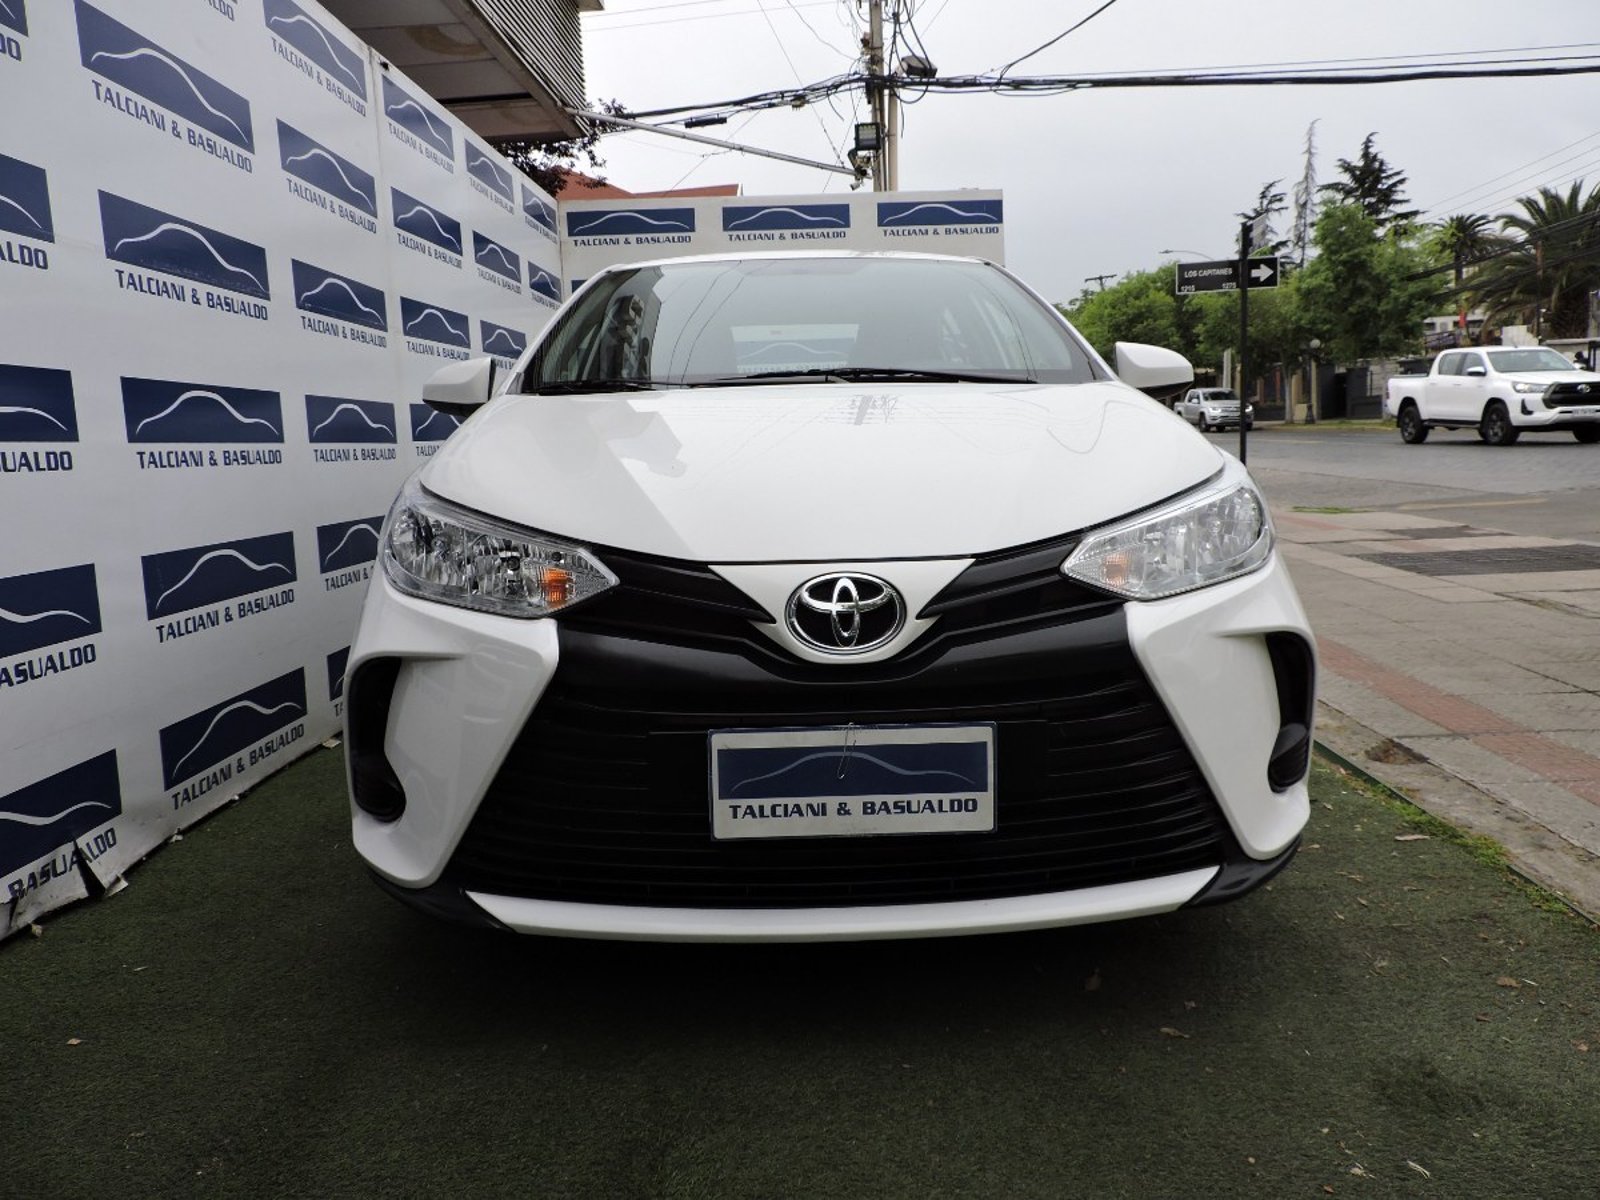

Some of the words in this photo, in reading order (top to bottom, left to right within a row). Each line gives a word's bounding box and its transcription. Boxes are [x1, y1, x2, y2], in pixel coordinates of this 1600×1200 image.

[272, 37, 314, 79] TALCIANI
[325, 77, 366, 117] BASUALDO
[92, 79, 166, 131] TALCIANI
[172, 120, 182, 139] &
[187, 127, 252, 173] BASUALDO
[286, 178, 327, 210] TALCIANI
[329, 200, 336, 214] &
[338, 204, 377, 234] BASUALDO
[573, 237, 619, 247] TALCIANI
[623, 237, 631, 245] &
[635, 235, 692, 245] BASUALDO
[728, 232, 774, 242] TALCIANI
[778, 232, 786, 241] &
[791, 230, 847, 240] BASUALDO
[883, 228, 929, 237] TALCIANI
[932, 227, 940, 236] &
[944, 226, 999, 236] BASUALDO
[1184, 270, 1198, 278] LOS
[115, 269, 186, 302] TALCIANI
[191, 287, 201, 305] &
[206, 292, 268, 321] BASUALDO
[301, 315, 339, 337] TALCIANI
[342, 326, 348, 339] &
[350, 328, 387, 348] BASUALDO
[0, 451, 73, 472] UALDO
[136, 450, 203, 469] TALCIANI
[208, 450, 217, 466] &
[223, 449, 282, 466] BASUALDO
[313, 448, 350, 462] TALCIANI
[353, 448, 359, 460] &
[361, 448, 397, 461] BASUALDO
[416, 445, 440, 457] TALCIA
[325, 570, 361, 591] TALCIANI
[363, 567, 369, 580] &
[156, 610, 219, 643] TALCIANI
[224, 606, 234, 622] &
[238, 589, 294, 619] BASUALDO
[172, 763, 231, 810] TALCIANI
[236, 757, 245, 773] &
[249, 723, 304, 766] BASUALDO
[729, 802, 827, 819] TALCIANI
[836, 801, 852, 816] &
[862, 798, 978, 816] BASUALDO
